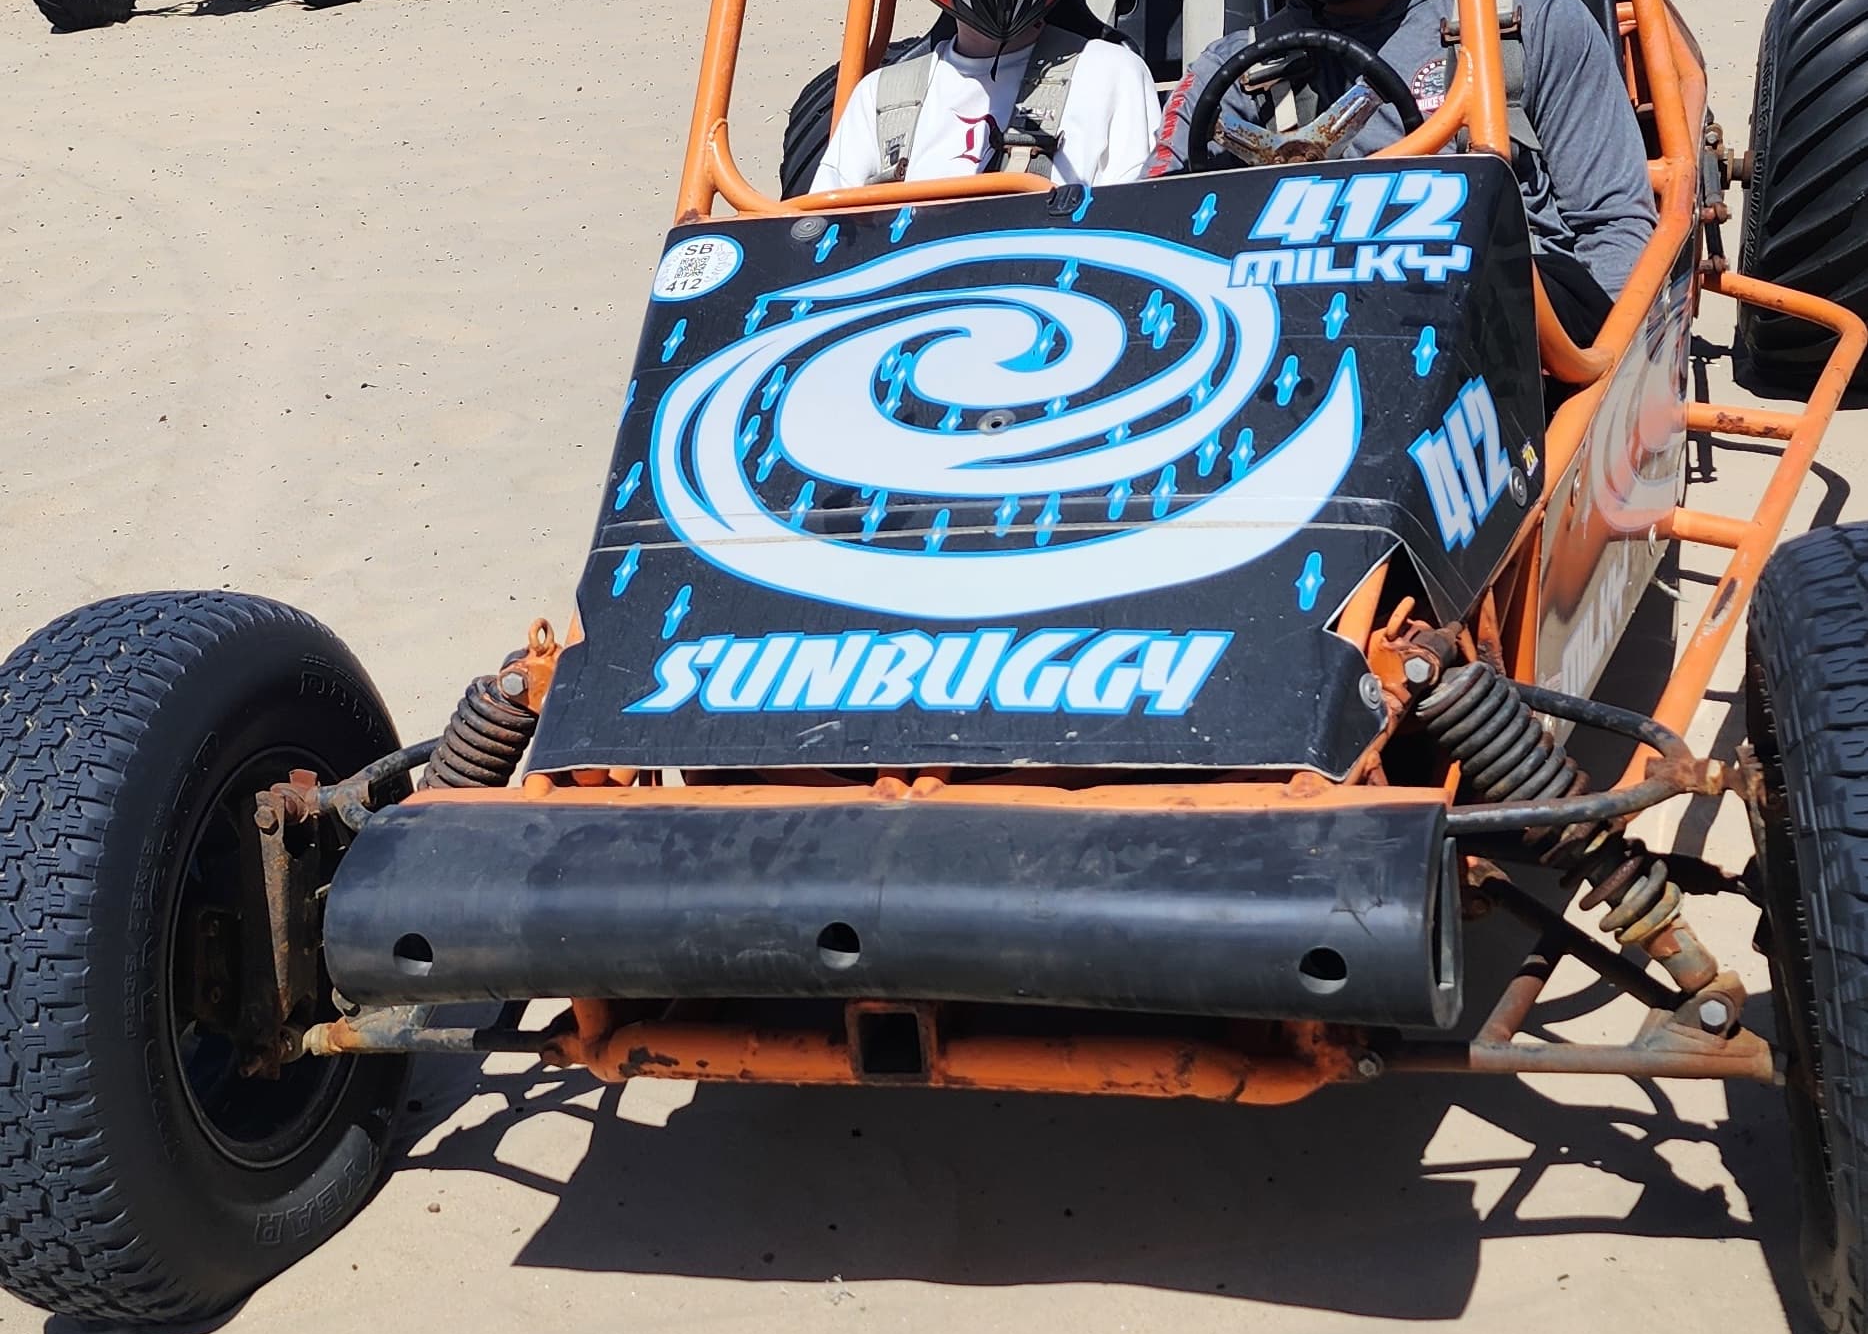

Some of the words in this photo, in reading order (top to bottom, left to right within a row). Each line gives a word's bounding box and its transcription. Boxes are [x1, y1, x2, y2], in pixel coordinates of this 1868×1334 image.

[1248, 169, 1469, 245] 412
[685, 243, 714, 256] SB
[1228, 244, 1473, 288] MILKY
[665, 278, 703, 292] 412
[1406, 374, 1512, 553] 412
[621, 627, 1235, 716] SUNBUGGY
